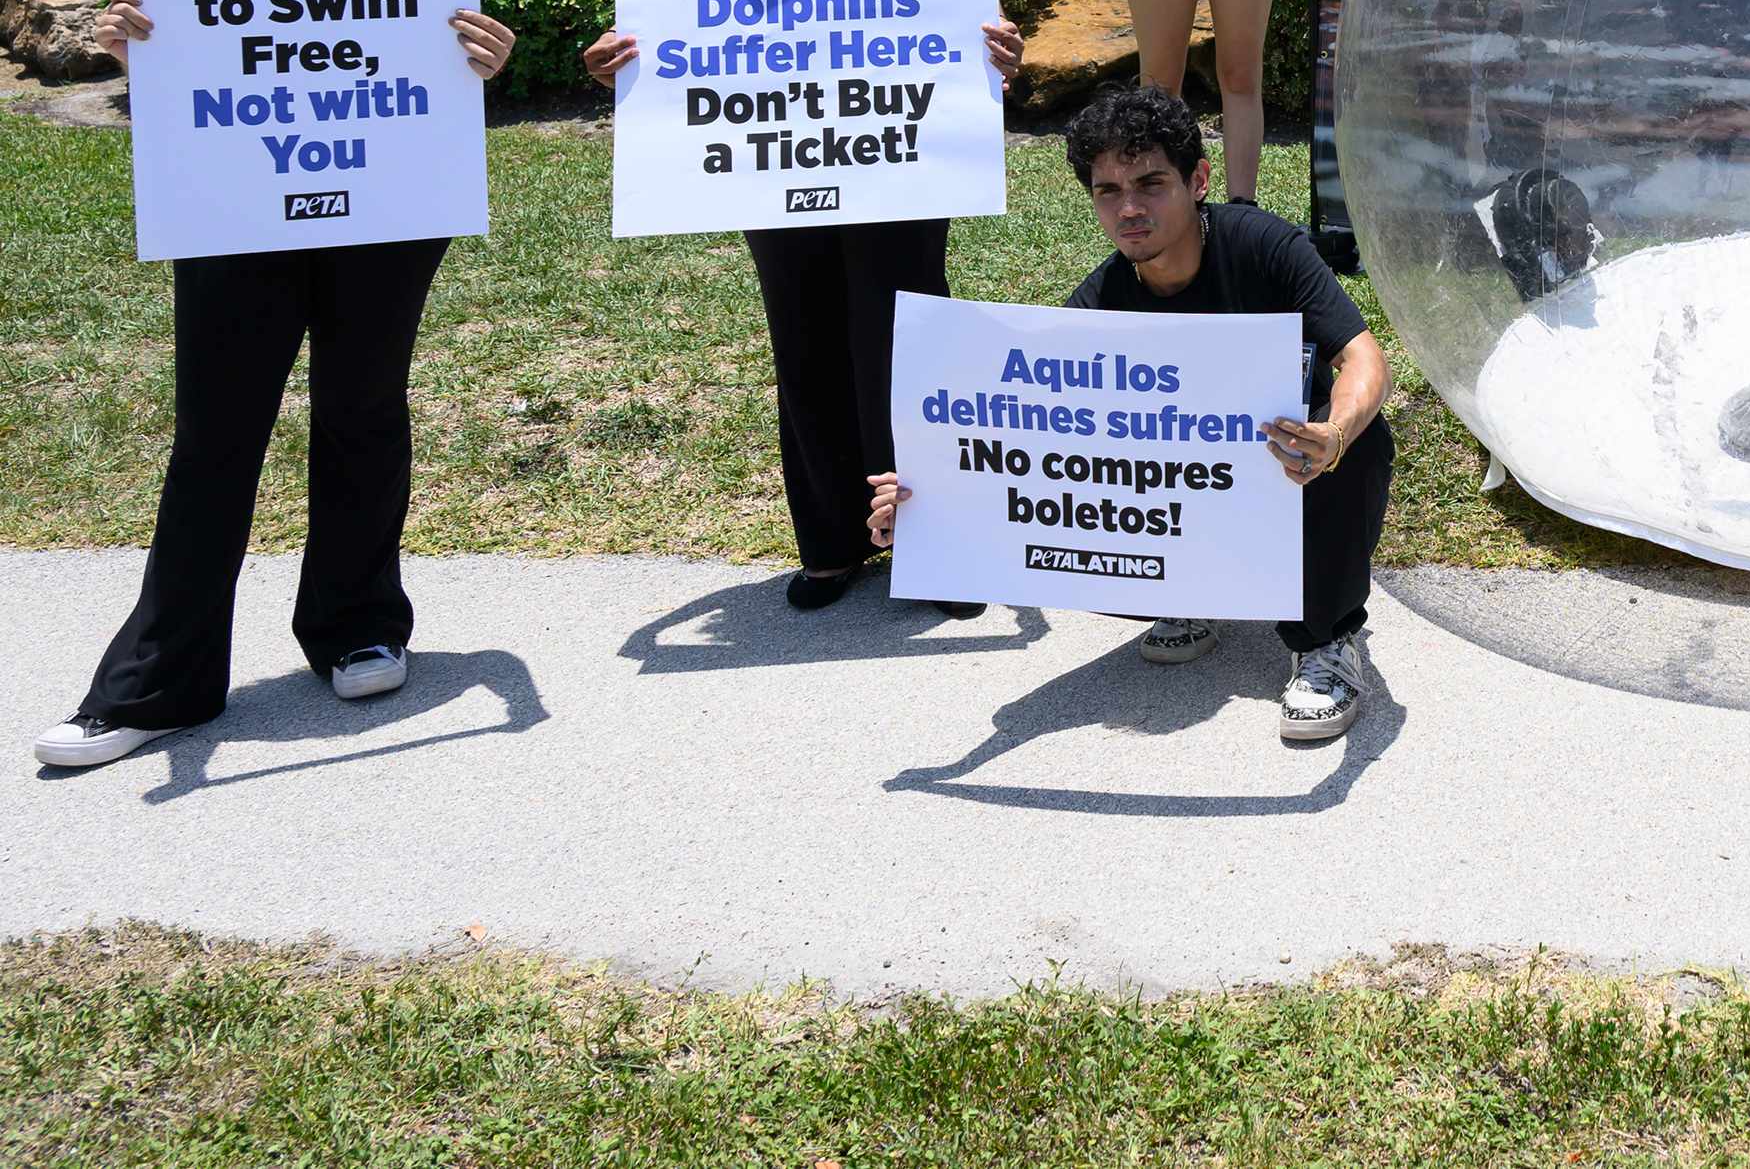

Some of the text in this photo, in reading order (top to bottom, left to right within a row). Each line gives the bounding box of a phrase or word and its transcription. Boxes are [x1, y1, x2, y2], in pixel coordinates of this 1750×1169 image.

[242, 36, 378, 76] Free,
[656, 30, 961, 78] Suffer Here.
[193, 78, 428, 128] Not with
[687, 79, 935, 125] Don't Buy
[261, 135, 365, 173] You
[704, 124, 918, 173] a Ticket!
[1001, 349, 1179, 393] Aquí los
[923, 389, 1267, 442] delfines sufren.
[958, 438, 1233, 494] ¡No compres
[1008, 487, 1181, 536] boletos!
